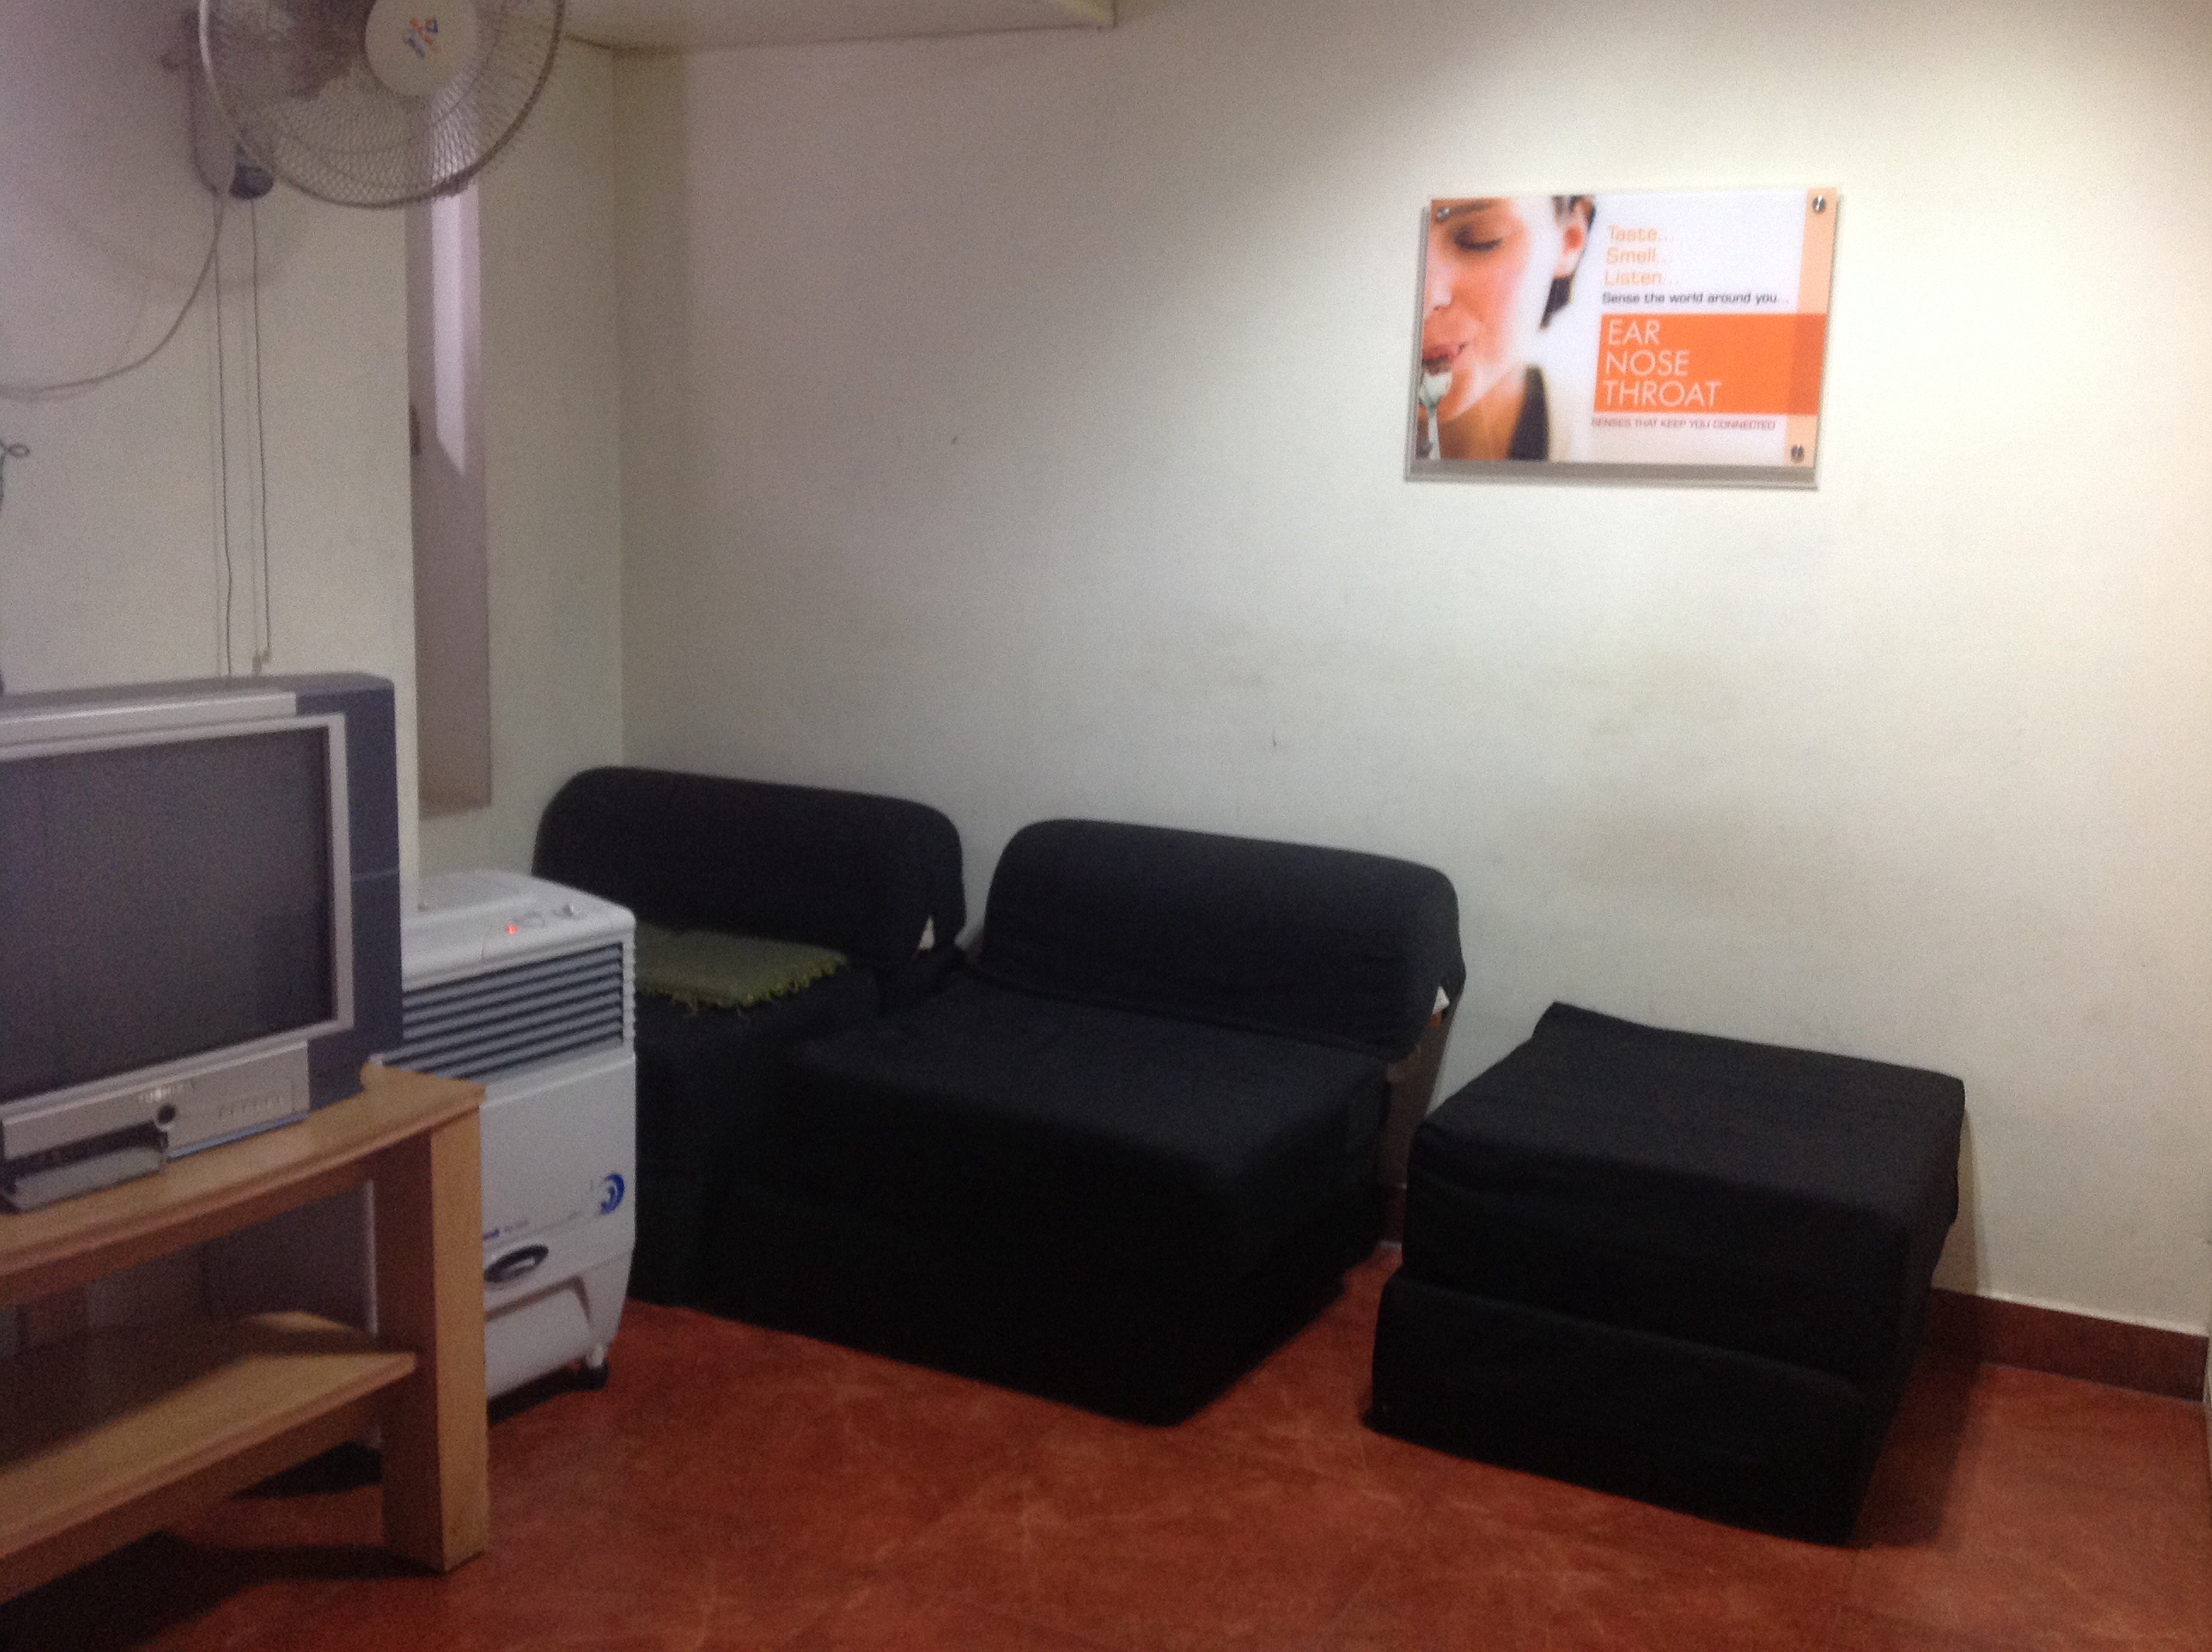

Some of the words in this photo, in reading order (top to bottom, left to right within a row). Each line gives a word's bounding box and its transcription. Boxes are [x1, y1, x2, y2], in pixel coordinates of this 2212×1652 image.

[1601, 292, 1640, 305] Sense
[1644, 292, 1665, 304] the
[1668, 292, 1703, 304] world
[1707, 292, 1751, 304] around
[1607, 318, 1662, 346] EAR
[1604, 348, 1691, 377] NOSE
[1602, 379, 1722, 408] THROAT
[1634, 418, 1657, 428] THAT
[1690, 419, 1710, 429] YOU
